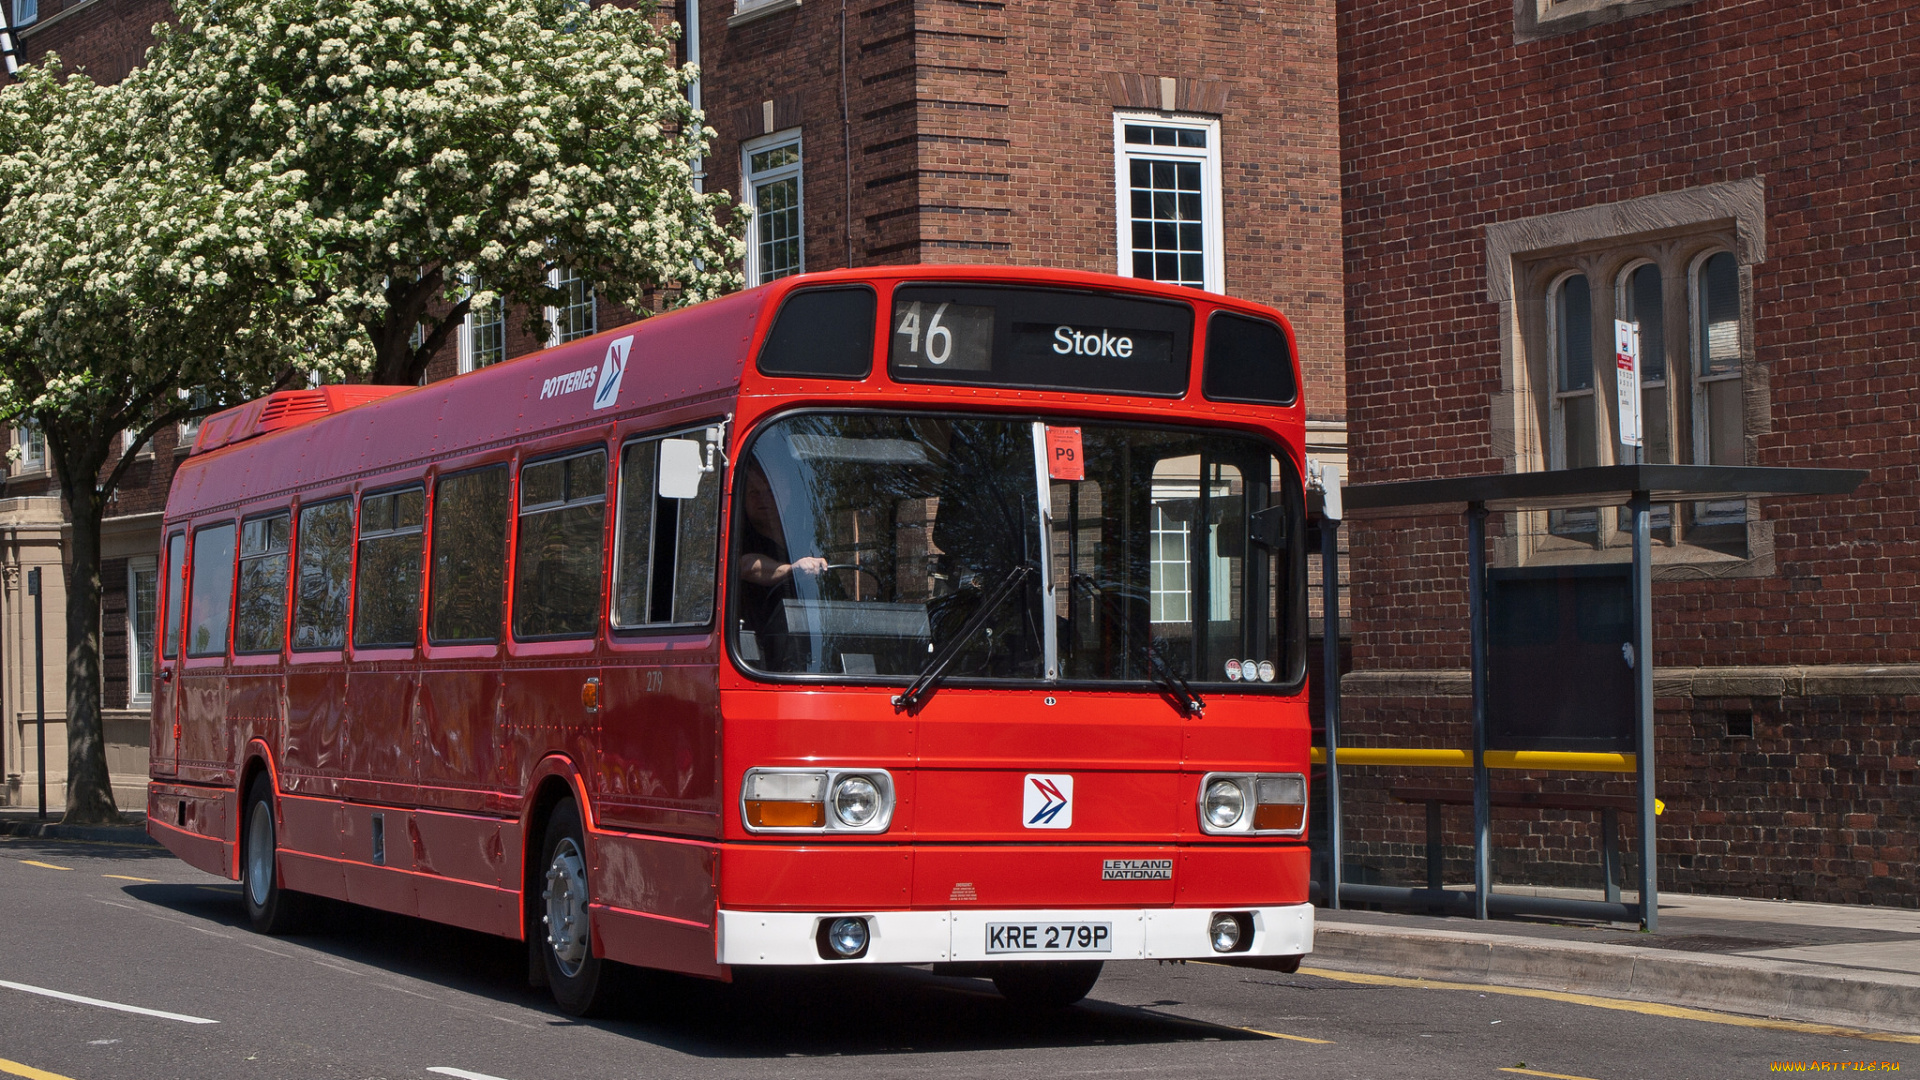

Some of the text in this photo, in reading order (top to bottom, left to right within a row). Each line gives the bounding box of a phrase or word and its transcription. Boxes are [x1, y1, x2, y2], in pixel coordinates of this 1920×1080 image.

[897, 301, 952, 365] 46
[1052, 325, 1134, 358] Stoke
[540, 365, 598, 401] POTTERIES
[1055, 447, 1075, 462] P9
[646, 671, 663, 692] 279
[1103, 870, 1171, 879] NATIONAL
[1104, 860, 1172, 869] LEYLAND
[990, 925, 1108, 949] KRE 279P
